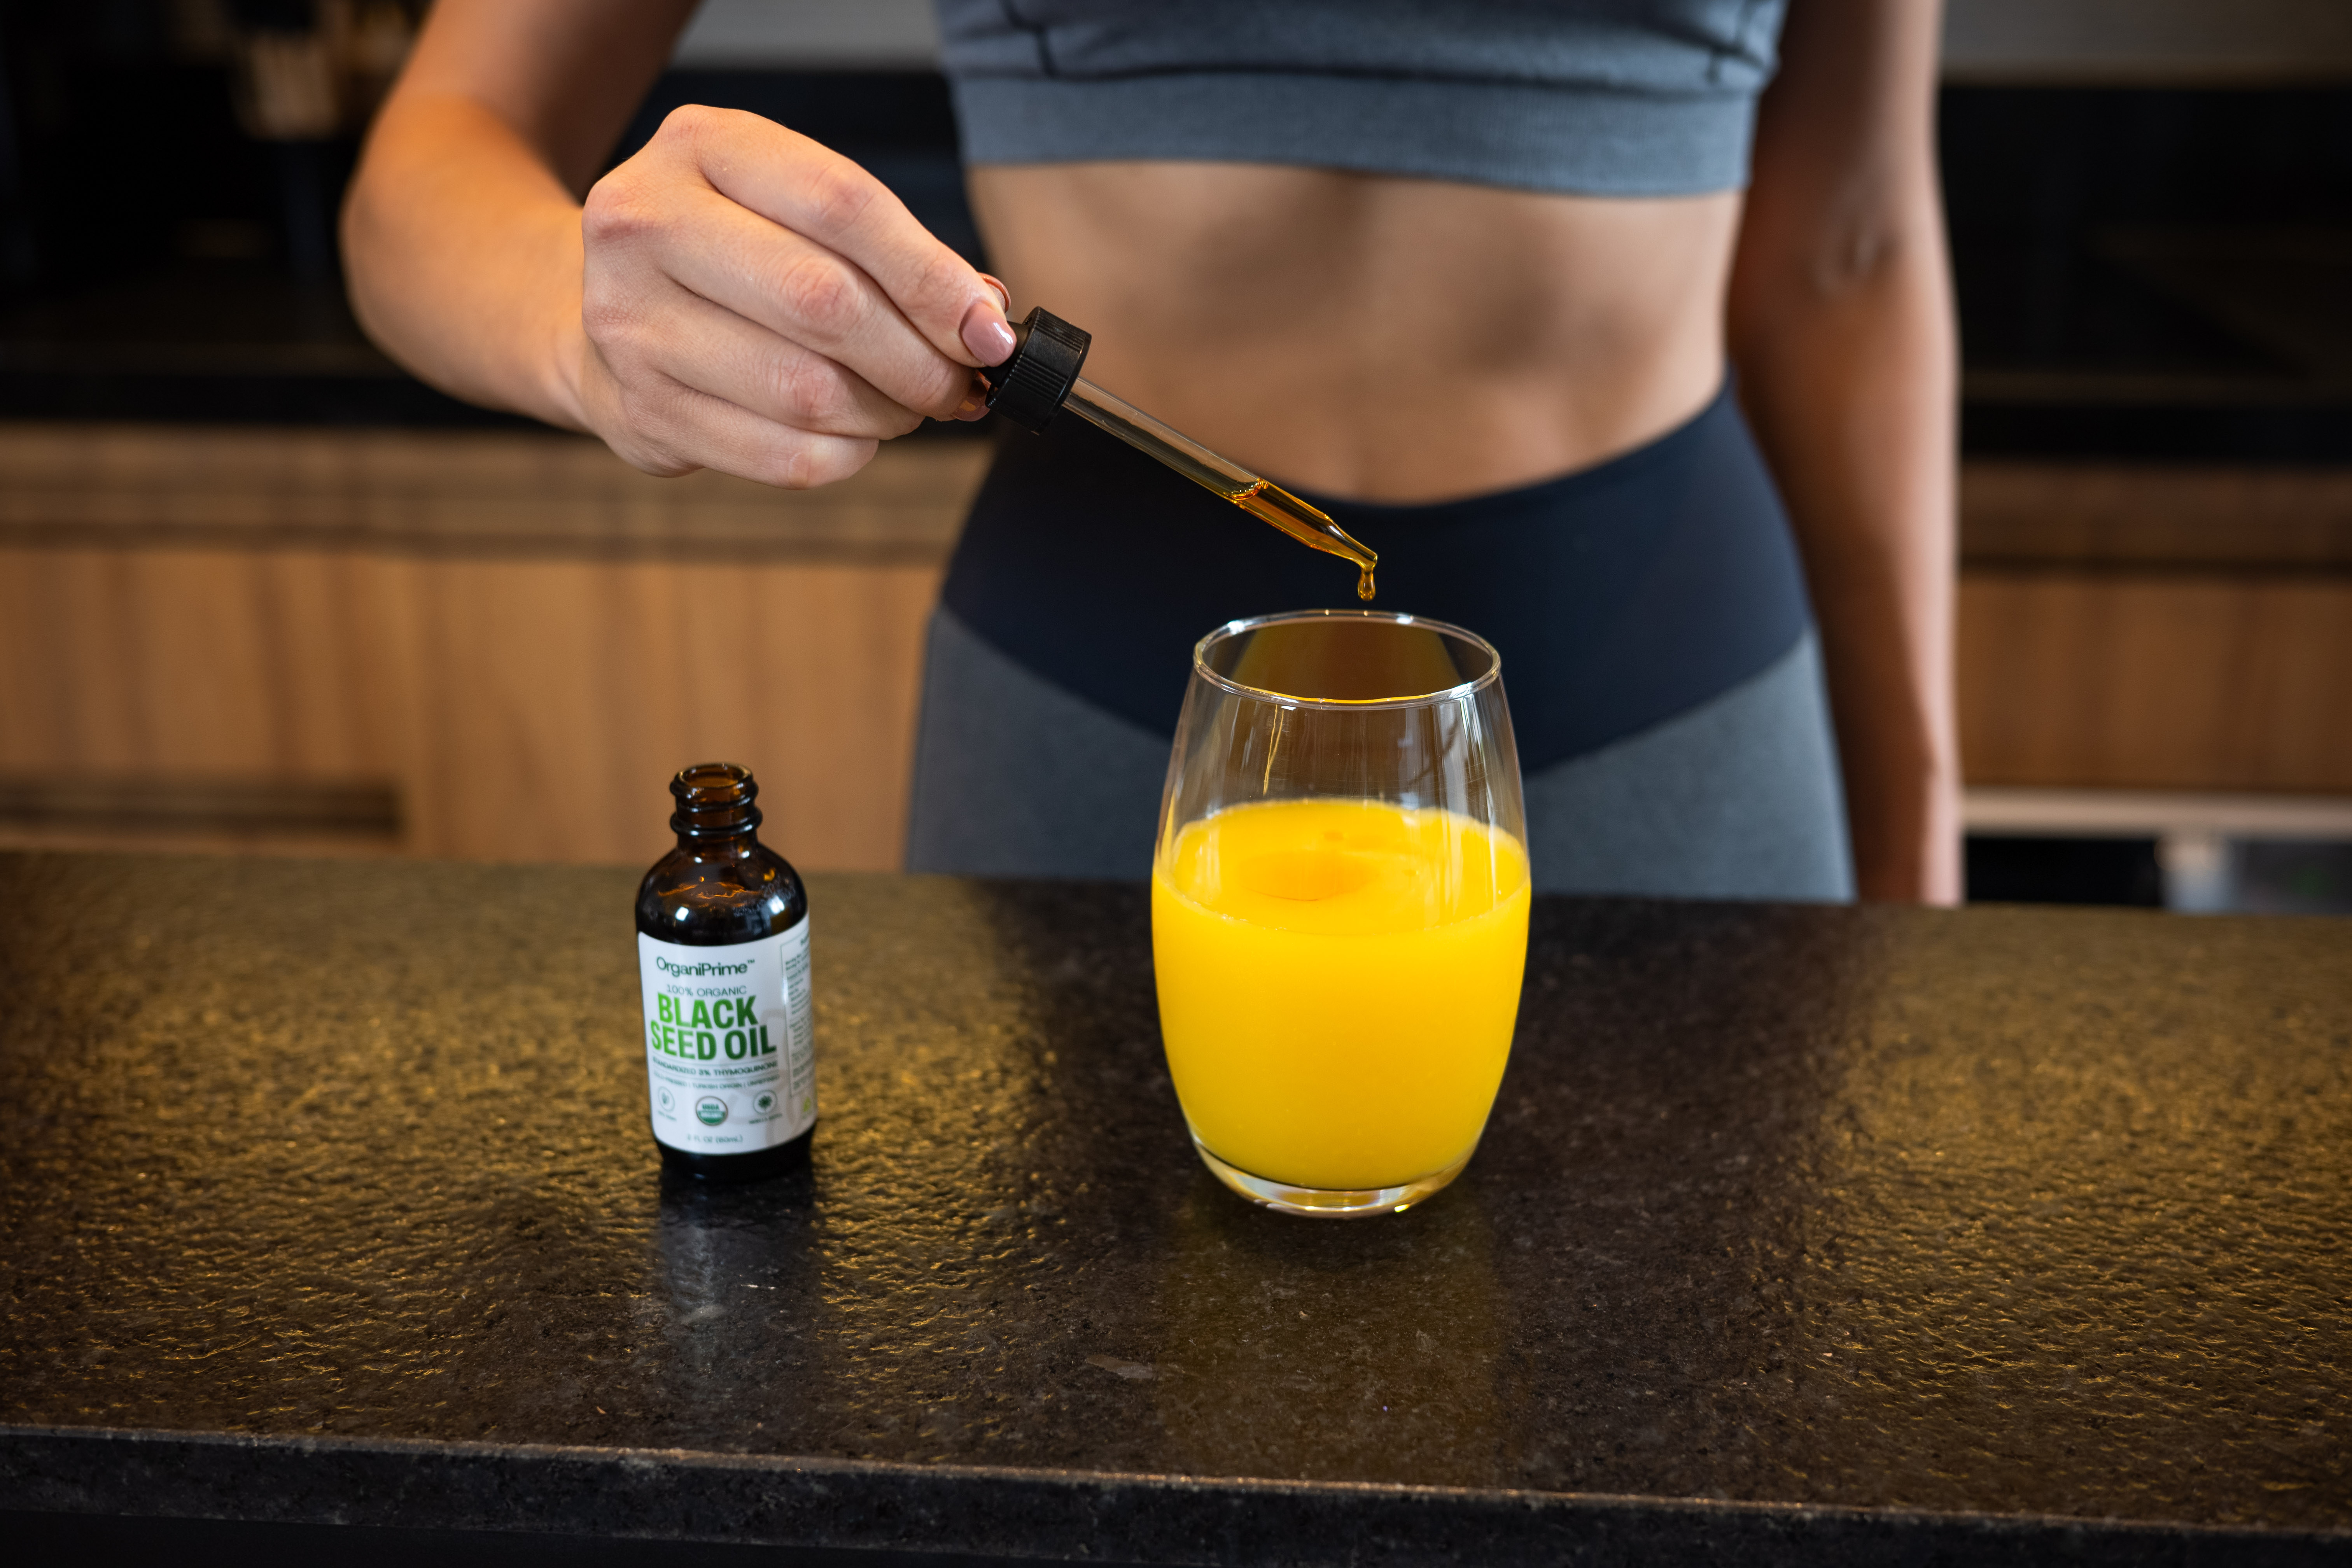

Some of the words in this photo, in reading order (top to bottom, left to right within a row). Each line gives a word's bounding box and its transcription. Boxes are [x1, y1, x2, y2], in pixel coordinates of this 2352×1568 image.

[667, 984, 693, 996] 100%
[697, 985, 747, 997] ORGANIC
[658, 992, 758, 1029] BLACK
[651, 1020, 717, 1060] SEED
[724, 1025, 777, 1059] OIL
